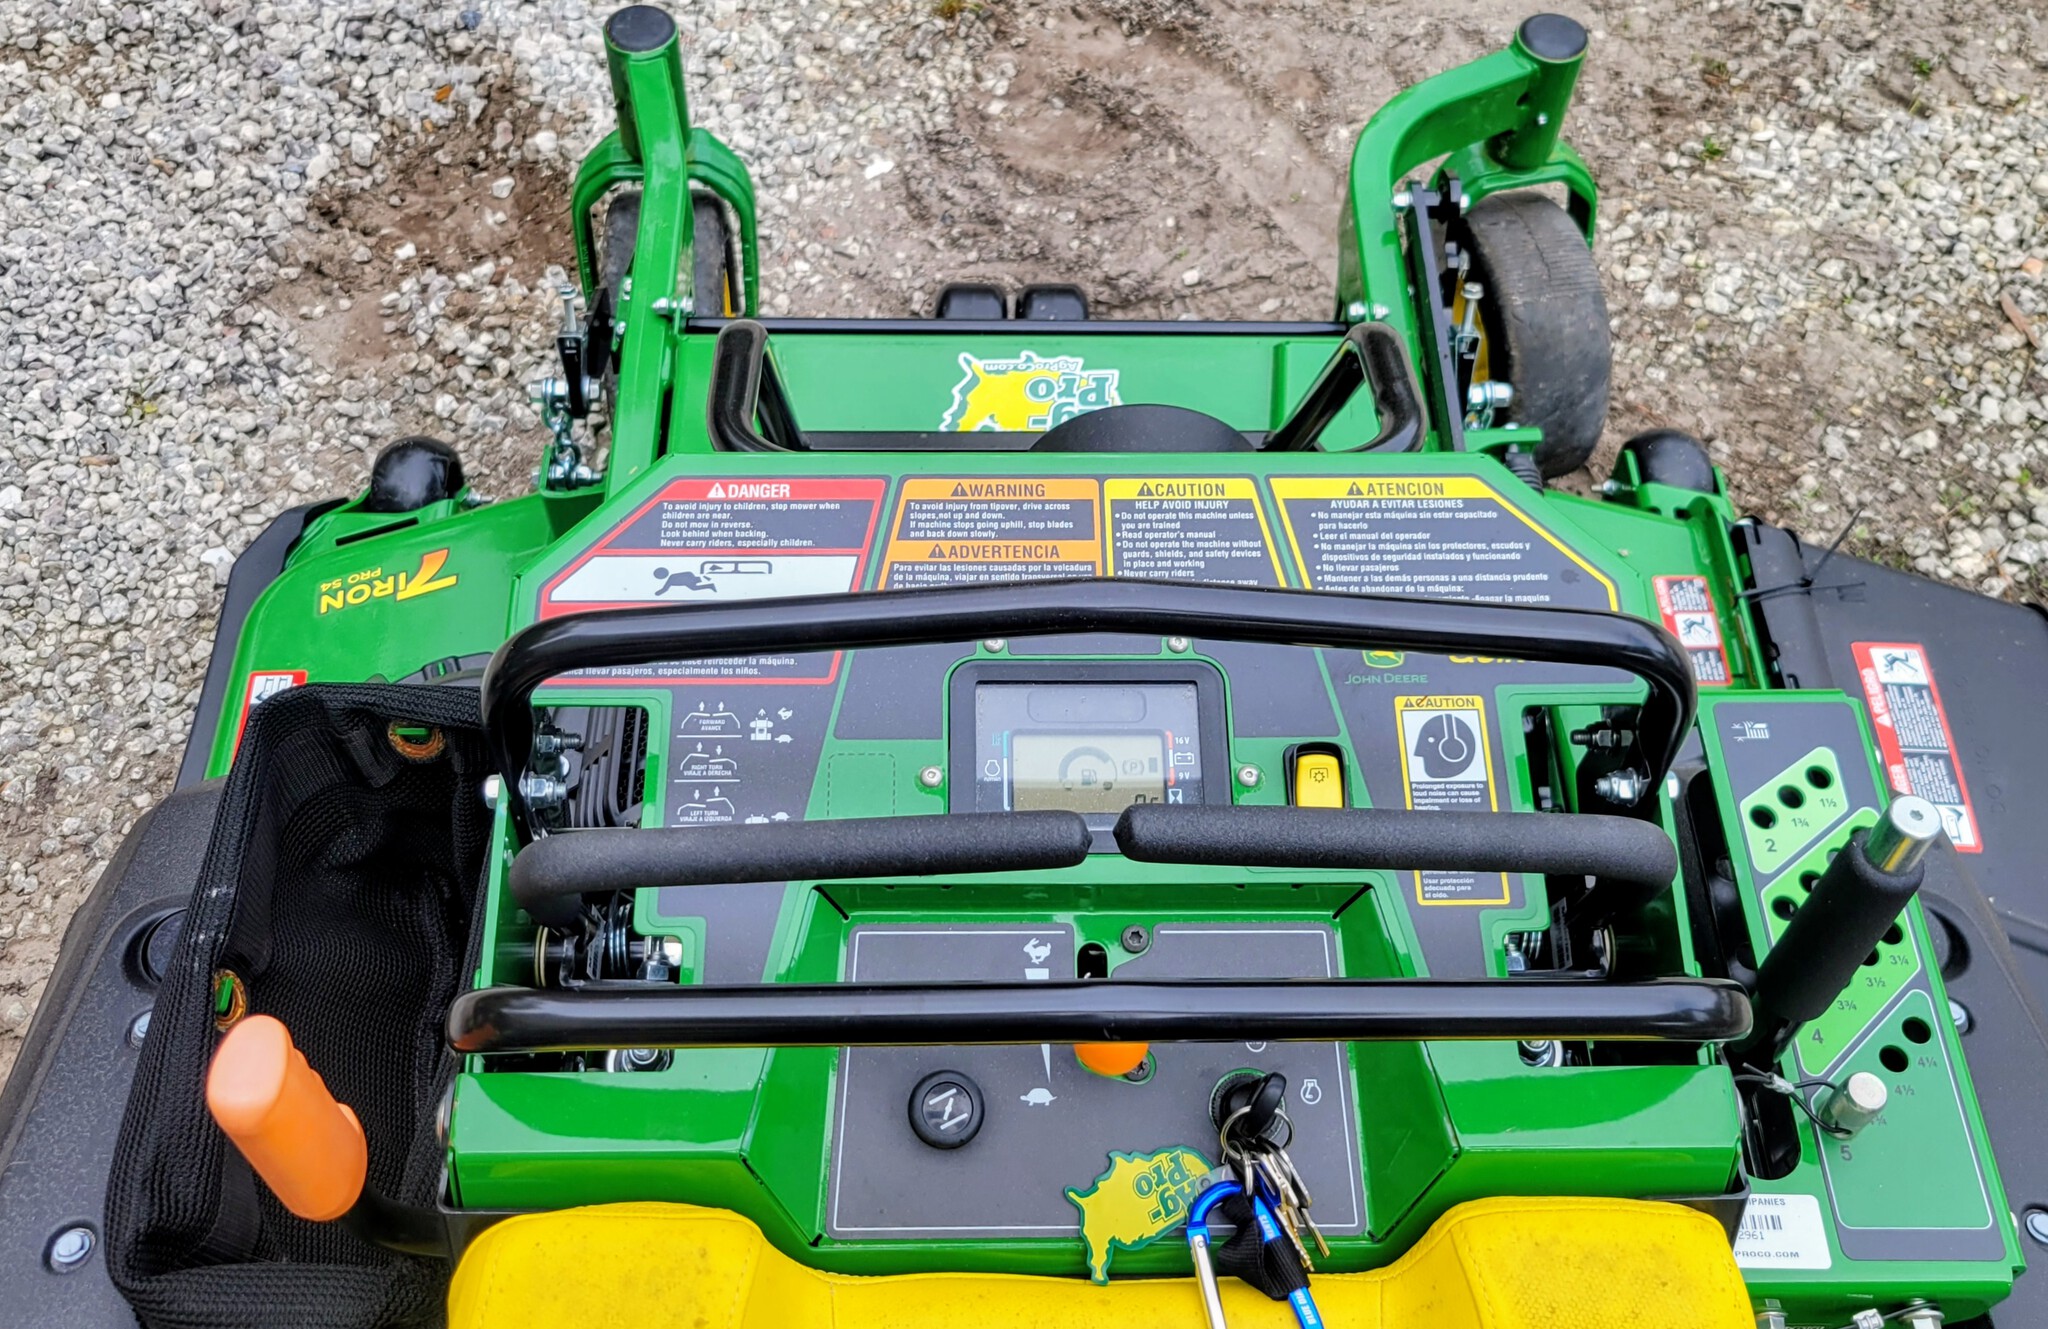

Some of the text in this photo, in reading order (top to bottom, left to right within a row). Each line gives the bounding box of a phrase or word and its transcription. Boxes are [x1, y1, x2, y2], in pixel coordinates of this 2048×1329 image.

[984, 360, 1079, 371] AgProCo.com
[1028, 376, 1109, 406] Pro
[728, 484, 790, 498] DANGER
[969, 484, 1045, 497] WARNING
[1155, 484, 1225, 496] CAUTION
[1367, 483, 1444, 496] ATENCION
[664, 503, 672, 511] To
[675, 503, 696, 511] avoid
[699, 503, 721, 512] injury
[724, 503, 731, 511] to
[734, 503, 768, 512] children,
[771, 503, 787, 512] stop
[910, 503, 919, 511] To
[922, 503, 943, 511] avoid
[946, 503, 967, 512] injury
[970, 503, 988, 511] from
[991, 503, 1020, 512] tipover,
[1023, 503, 1042, 511] drive
[1136, 501, 1229, 510] HELP AVOID INJURY
[1331, 500, 1463, 509] AYUDAR A EVITAR LESIONES
[663, 512, 694, 520] children
[953, 513, 962, 521] up
[965, 512, 979, 520] and
[982, 512, 1005, 520] down.
[1122, 512, 1253, 522] Do not operate this machine unless
[662, 521, 672, 529] Do
[953, 522, 974, 530] stops
[977, 522, 998, 530] going
[1001, 522, 1026, 530] uphill,
[1028, 522, 1045, 530] stop
[1122, 523, 1135, 531] you
[1153, 522, 1180, 530] trained
[1319, 522, 1368, 531] para hacerlo
[735, 531, 768, 539] backing.
[970, 531, 998, 539] slowly.
[1123, 531, 1215, 540] Read operator's manual
[1320, 533, 1337, 541] Leer
[1350, 532, 1378, 540] manual
[1381, 532, 1393, 540] del
[1395, 532, 1430, 541] operador
[687, 541, 706, 549] carry
[709, 540, 734, 549] riders,
[738, 540, 777, 549] especially
[948, 545, 1060, 558] ADVERTENCIA
[1323, 564, 1399, 573] No llevar pasajeros
[1124, 570, 1194, 579] Never carry riders
[320, 567, 382, 592] PRO 54
[704, 658, 746, 666] retroceder
[749, 657, 757, 665] la
[759, 656, 797, 666] máquina.
[586, 666, 760, 677] llevar pasajeros, especialmente los niños.
[1345, 673, 1428, 684] JOHN DEERE
[1862, 667, 1886, 713] PELIGRO
[1416, 698, 1475, 708] CAUTION
[1175, 737, 1190, 745] 16 V
[1179, 772, 1190, 780] 9 V
[1766, 839, 1777, 853] 2
[1440, 877, 1474, 886] protección
[1812, 1028, 1824, 1044] 4
[1840, 1145, 1852, 1161] 5
[1136, 1150, 1186, 1200] Pro
